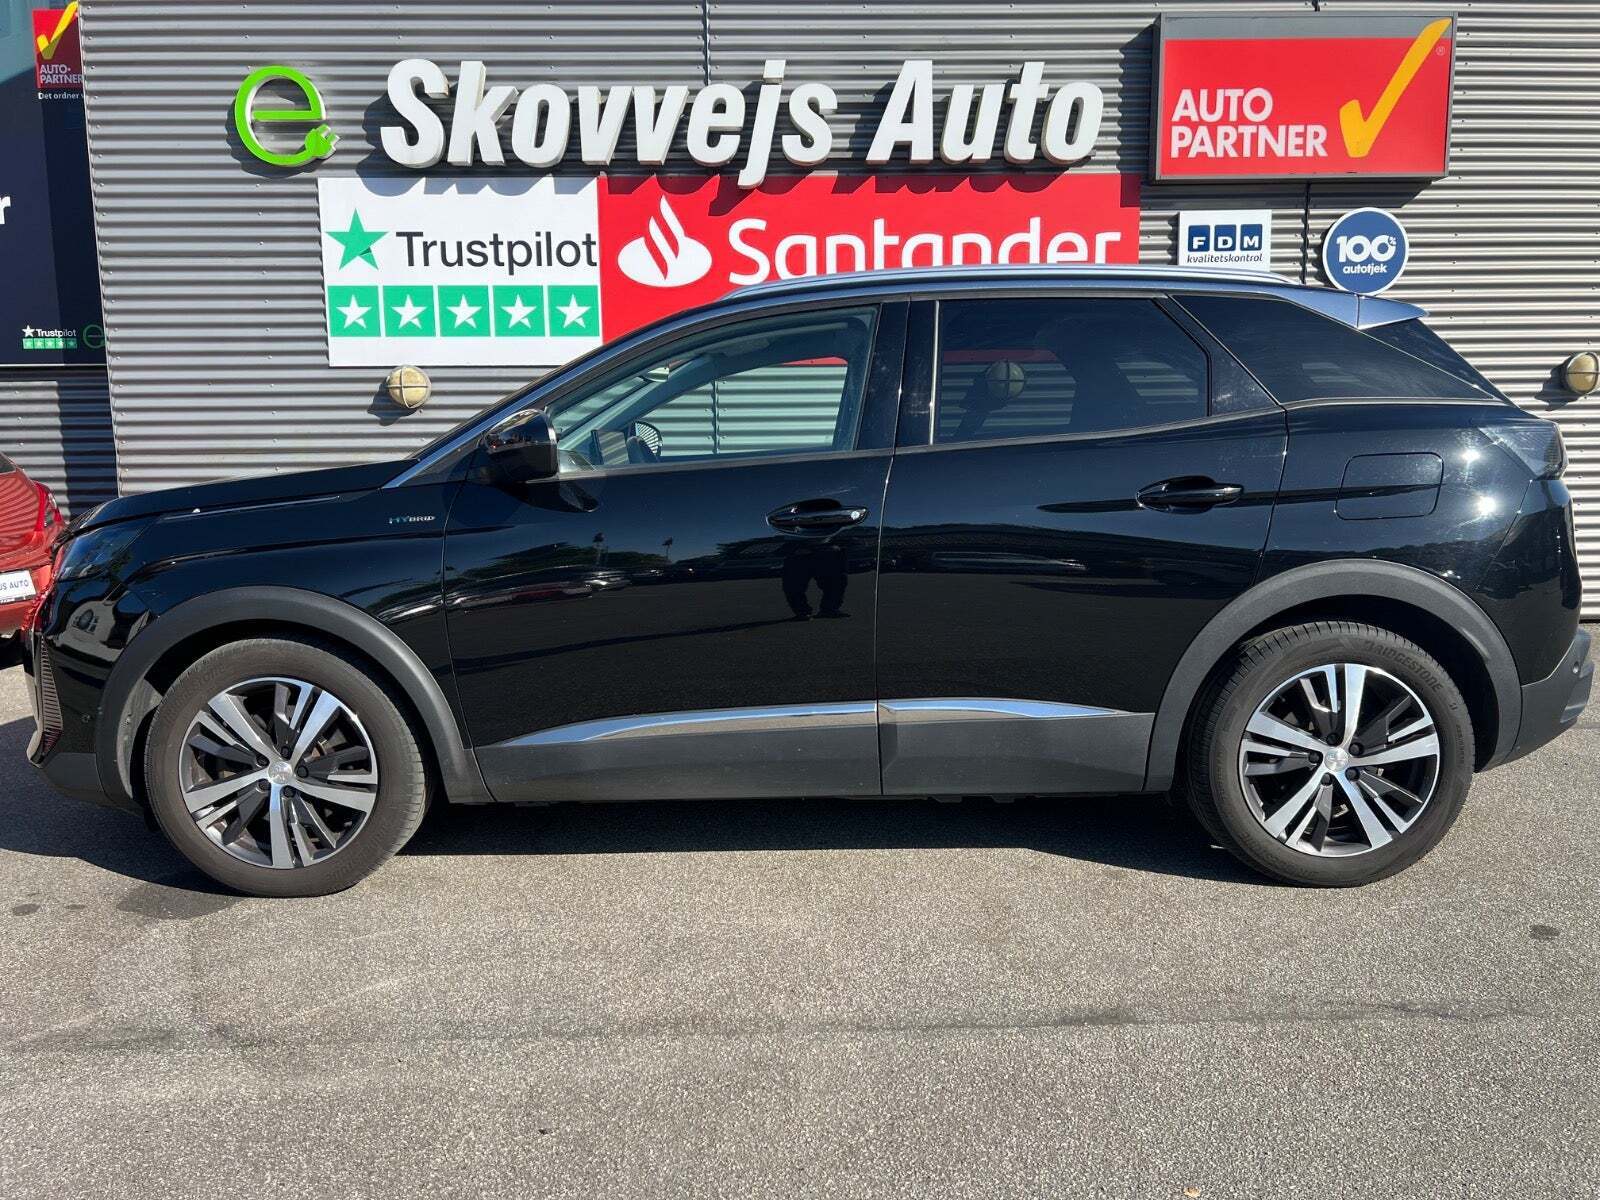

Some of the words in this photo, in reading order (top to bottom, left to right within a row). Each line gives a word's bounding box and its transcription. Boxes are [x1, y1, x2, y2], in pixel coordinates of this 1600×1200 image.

[1171, 87, 1273, 123] AUTO
[380, 58, 838, 189] Skovvejs
[866, 59, 1104, 165] Auto
[1170, 124, 1328, 158] PARTNER
[396, 231, 598, 276] Trustpilot
[728, 216, 1122, 286] Santander
[1186, 253, 1263, 264] kvalitetskontrol
[1342, 263, 1388, 275] autotjek
[36, 328, 76, 338] Trustpilot
[388, 515, 437, 525] HYBRID
[9, 579, 29, 589] AUTO
